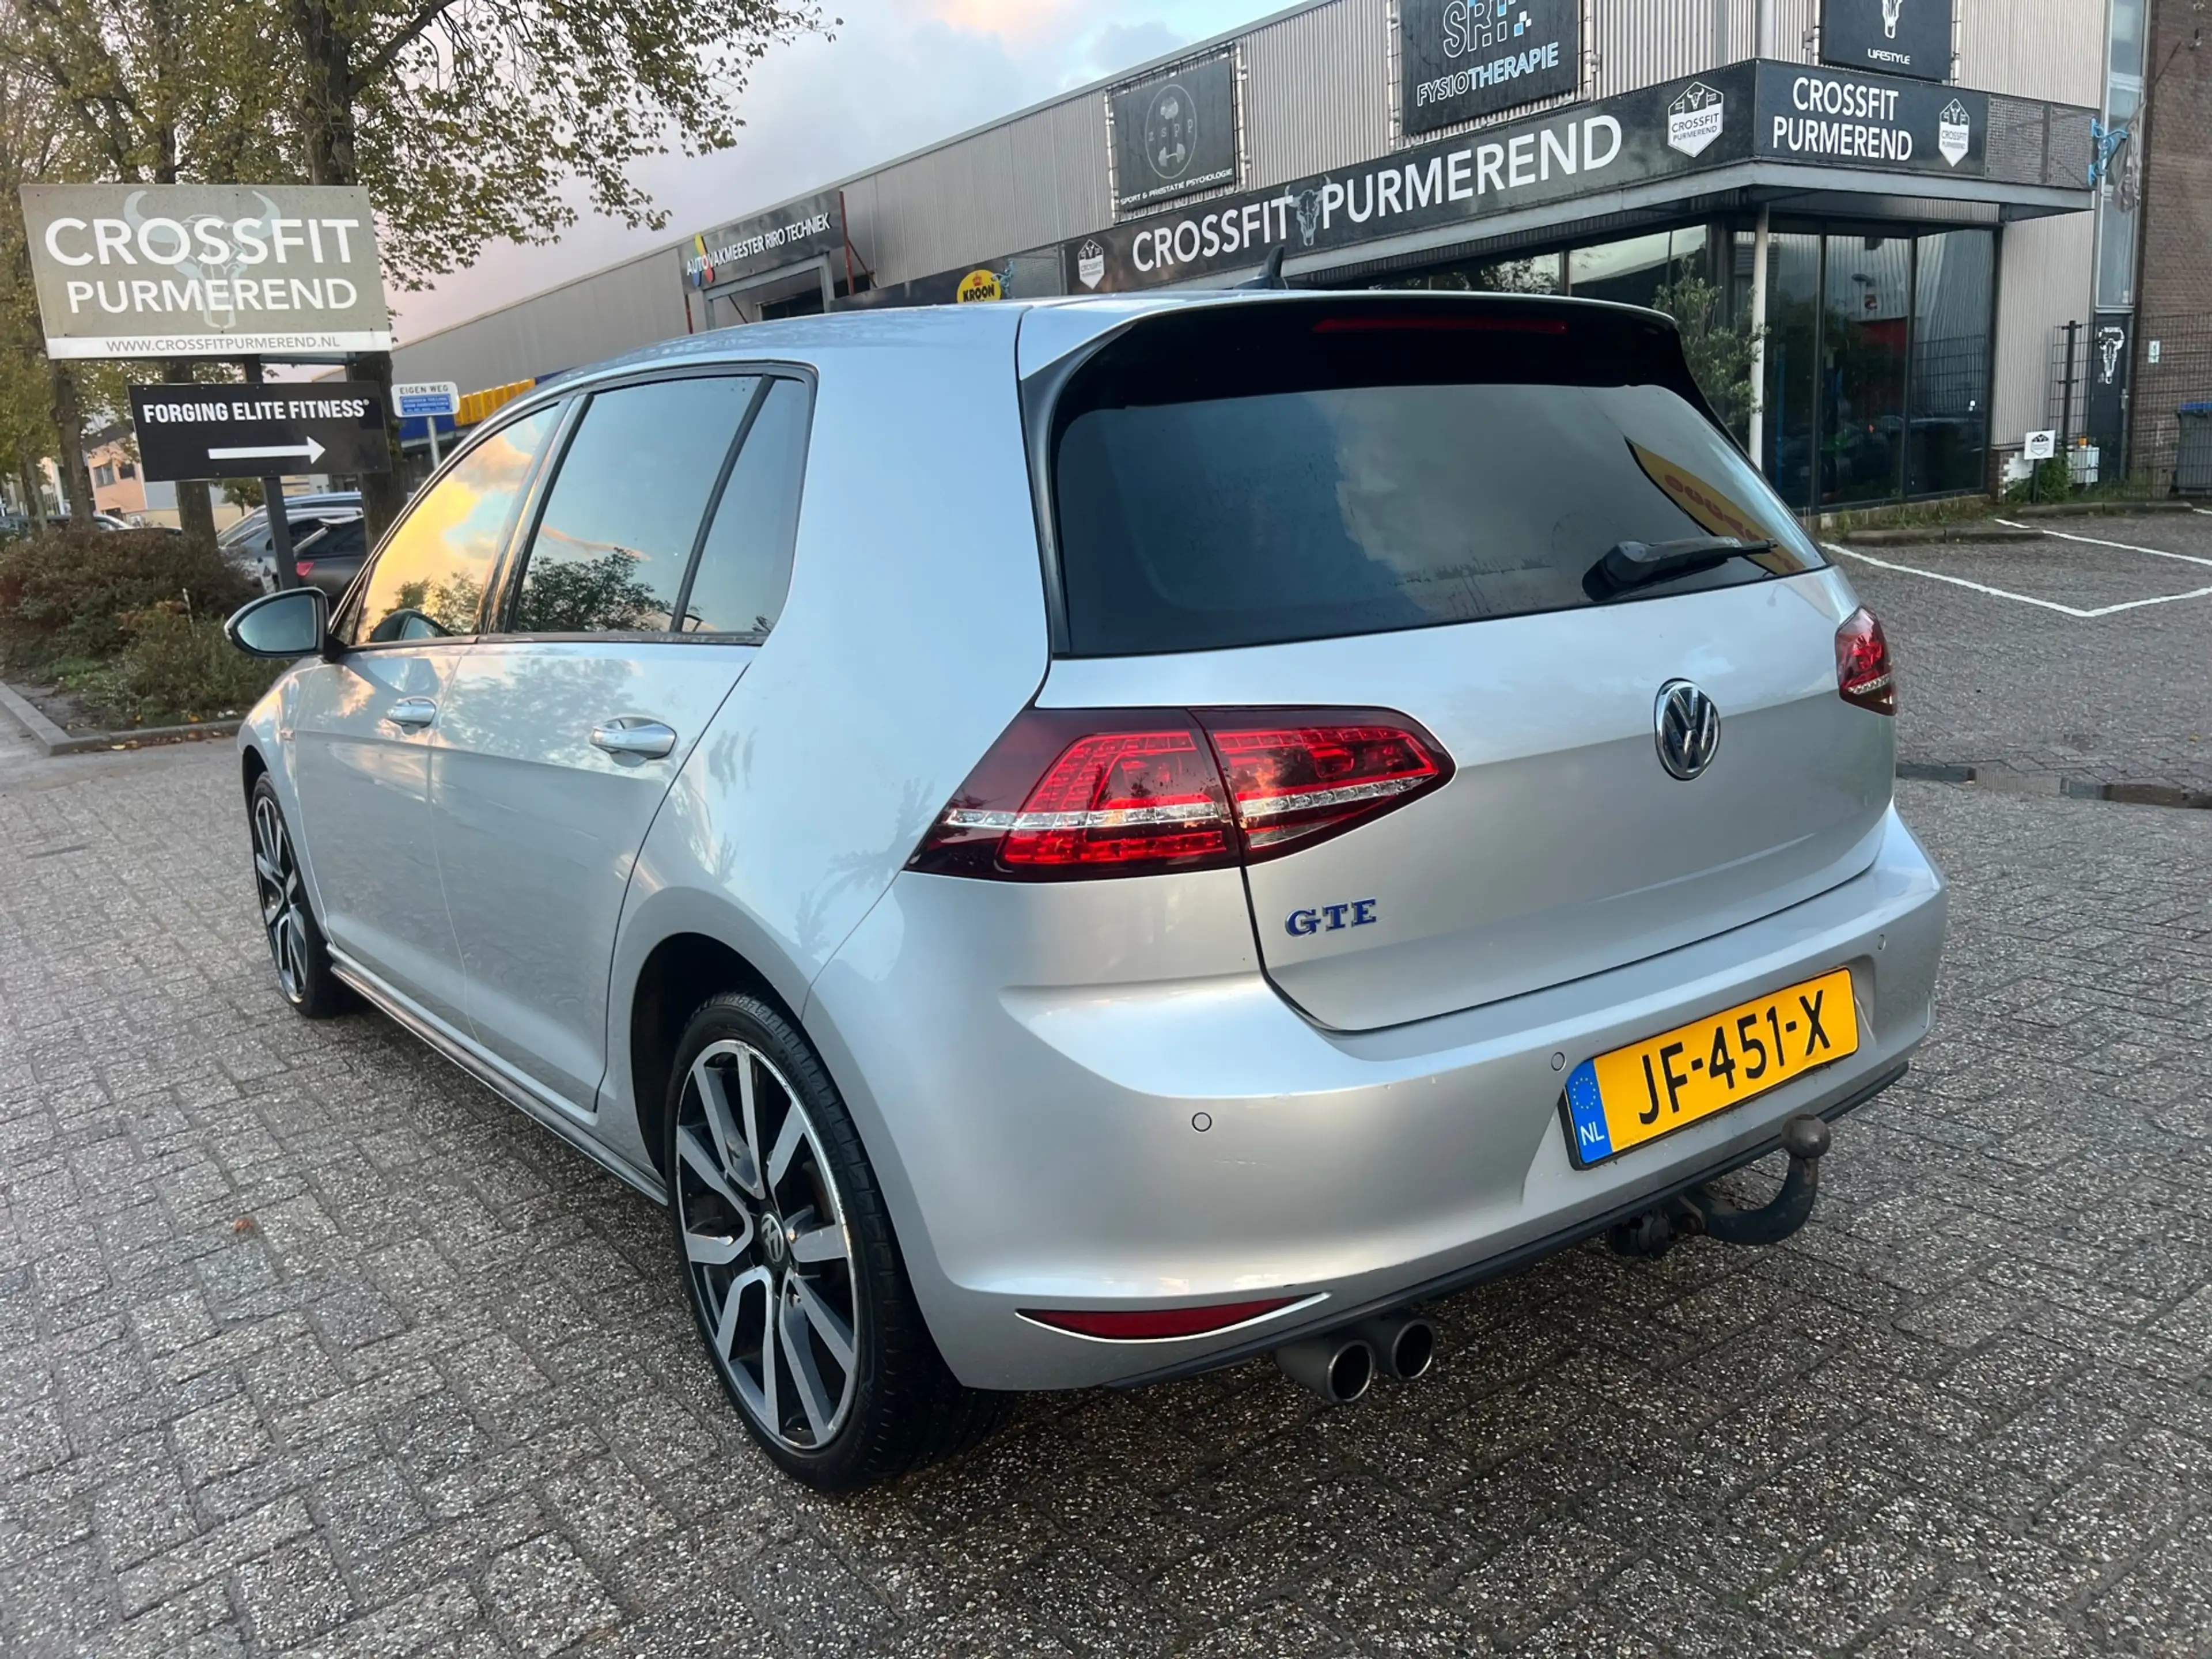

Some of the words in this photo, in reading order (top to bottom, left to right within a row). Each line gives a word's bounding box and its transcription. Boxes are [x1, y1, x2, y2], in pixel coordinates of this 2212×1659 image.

[1416, 41, 1559, 107] FYSIOTHERAPIE
[1867, 48, 1911, 66] LIFESTYLE
[1792, 76, 1899, 122] CROSSFIT
[1671, 113, 1719, 133] CROSSFIT
[1672, 125, 1718, 142] PURMEREND
[1772, 115, 1912, 162] PURMEREND
[1119, 193, 1141, 205] SPORT
[1149, 180, 1185, 197] PRESTATIE
[1185, 168, 1233, 188] PSYCHOLOGIE
[1132, 194, 1293, 272] CROSSFIT
[1322, 115, 1622, 230] PURMEREND
[45, 217, 359, 266] CROSSFIT
[686, 237, 764, 276] AUTOVAKMEESTER
[764, 228, 786, 250] RIRO
[786, 213, 831, 243] TECHNIEK
[66, 278, 357, 313] PURMEREND
[963, 283, 995, 302] KROON
[106, 335, 340, 353] WWW.CROSSFITPURMEREND.NL
[399, 386, 427, 395] EIGEN
[429, 384, 449, 392] WEG
[142, 402, 229, 423] FORGING
[232, 402, 286, 421] ELITE
[1285, 896, 1377, 938] GTE
[1638, 989, 1832, 1125] JF-451-X
[1579, 1120, 1605, 1146] NL
